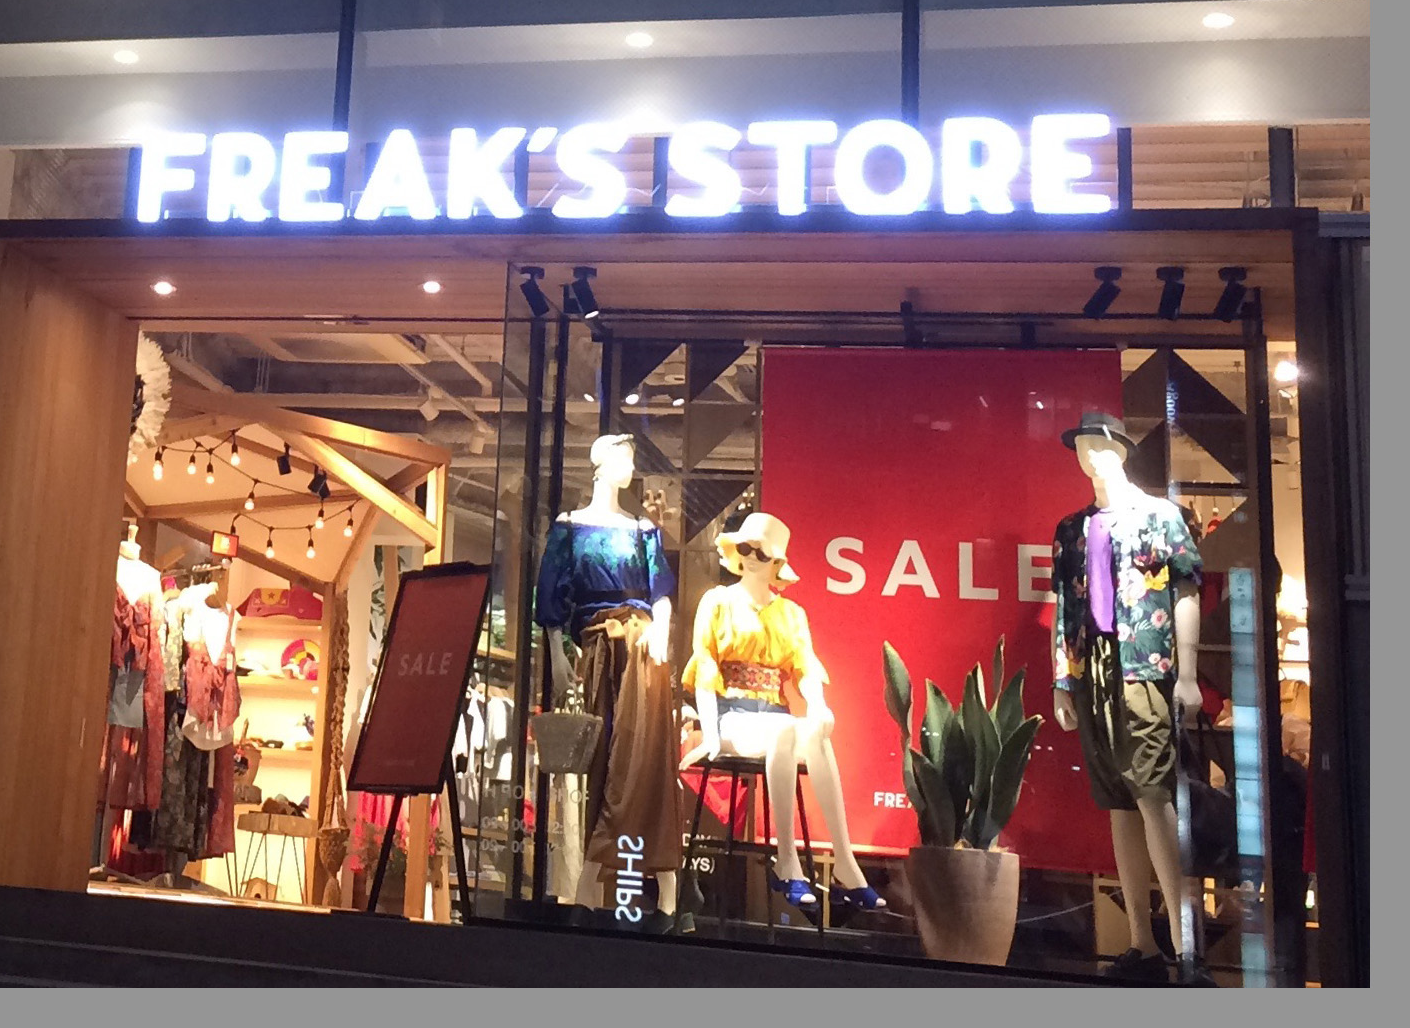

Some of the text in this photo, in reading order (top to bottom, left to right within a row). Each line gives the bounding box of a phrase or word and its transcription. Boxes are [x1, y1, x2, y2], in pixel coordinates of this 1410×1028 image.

[134, 113, 1112, 223] FREAK'S STORE
[825, 536, 1058, 603] SALE
[398, 652, 452, 676] SALE
